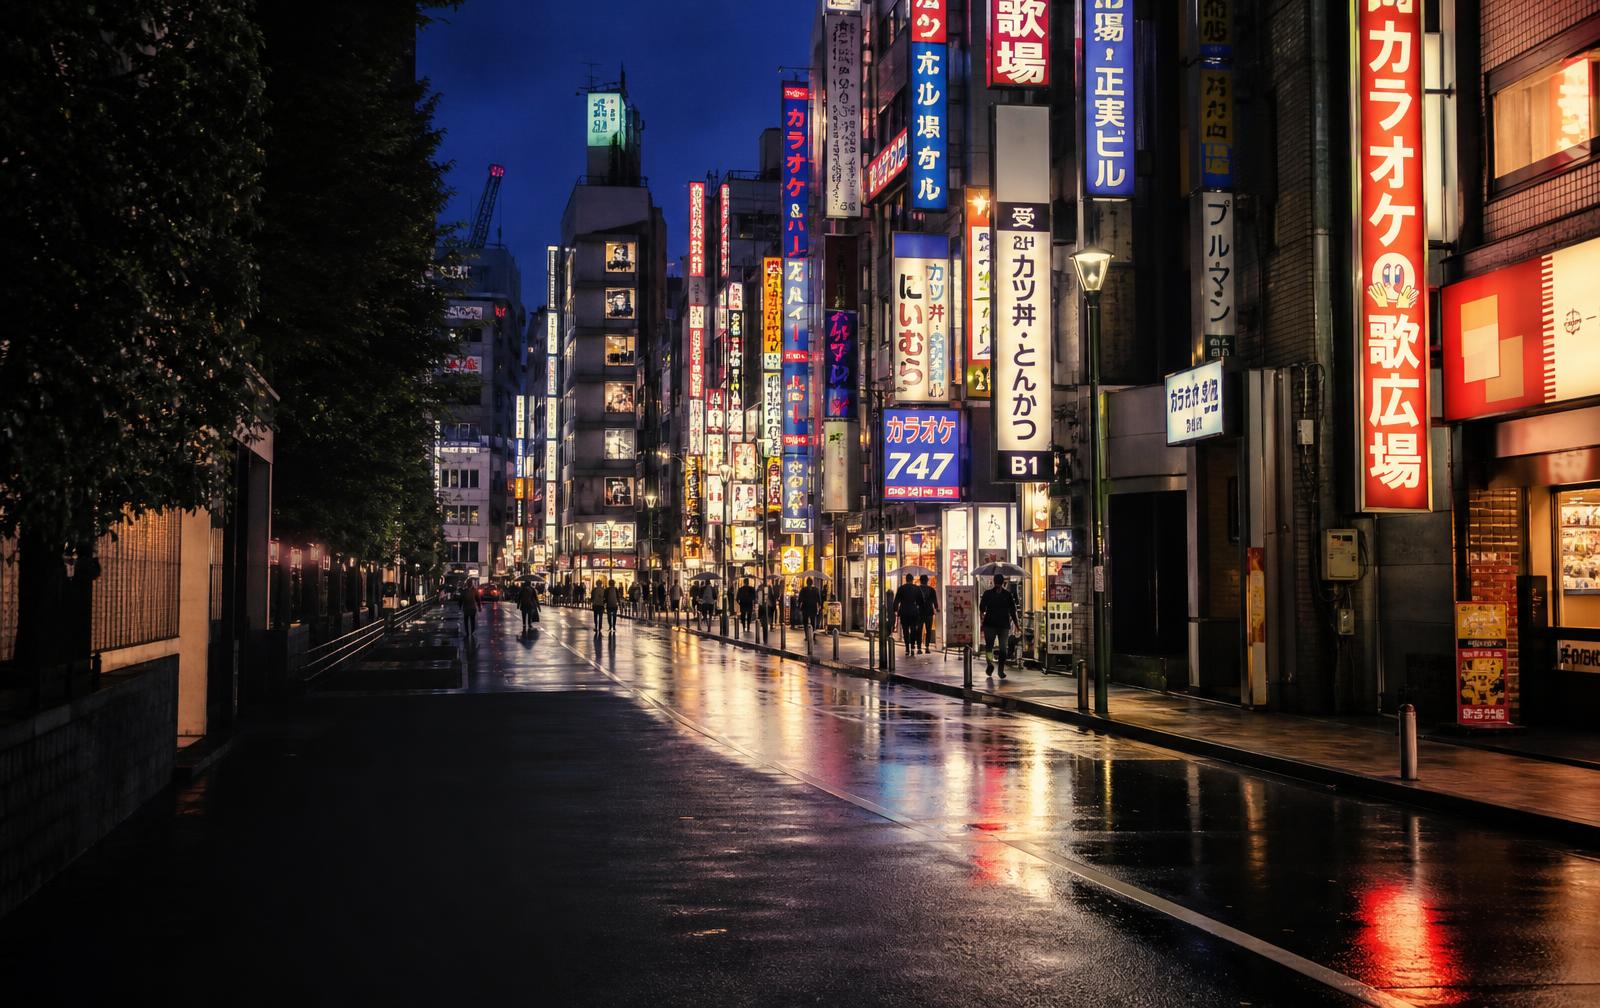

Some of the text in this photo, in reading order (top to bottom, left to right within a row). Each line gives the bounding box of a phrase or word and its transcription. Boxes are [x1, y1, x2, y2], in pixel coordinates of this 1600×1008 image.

[898, 273, 924, 387] にいむら
[1368, 313, 1422, 490] 歌広場
[886, 415, 956, 445] カラオケ
[886, 452, 955, 481] 747
[1010, 456, 1038, 475] B1
